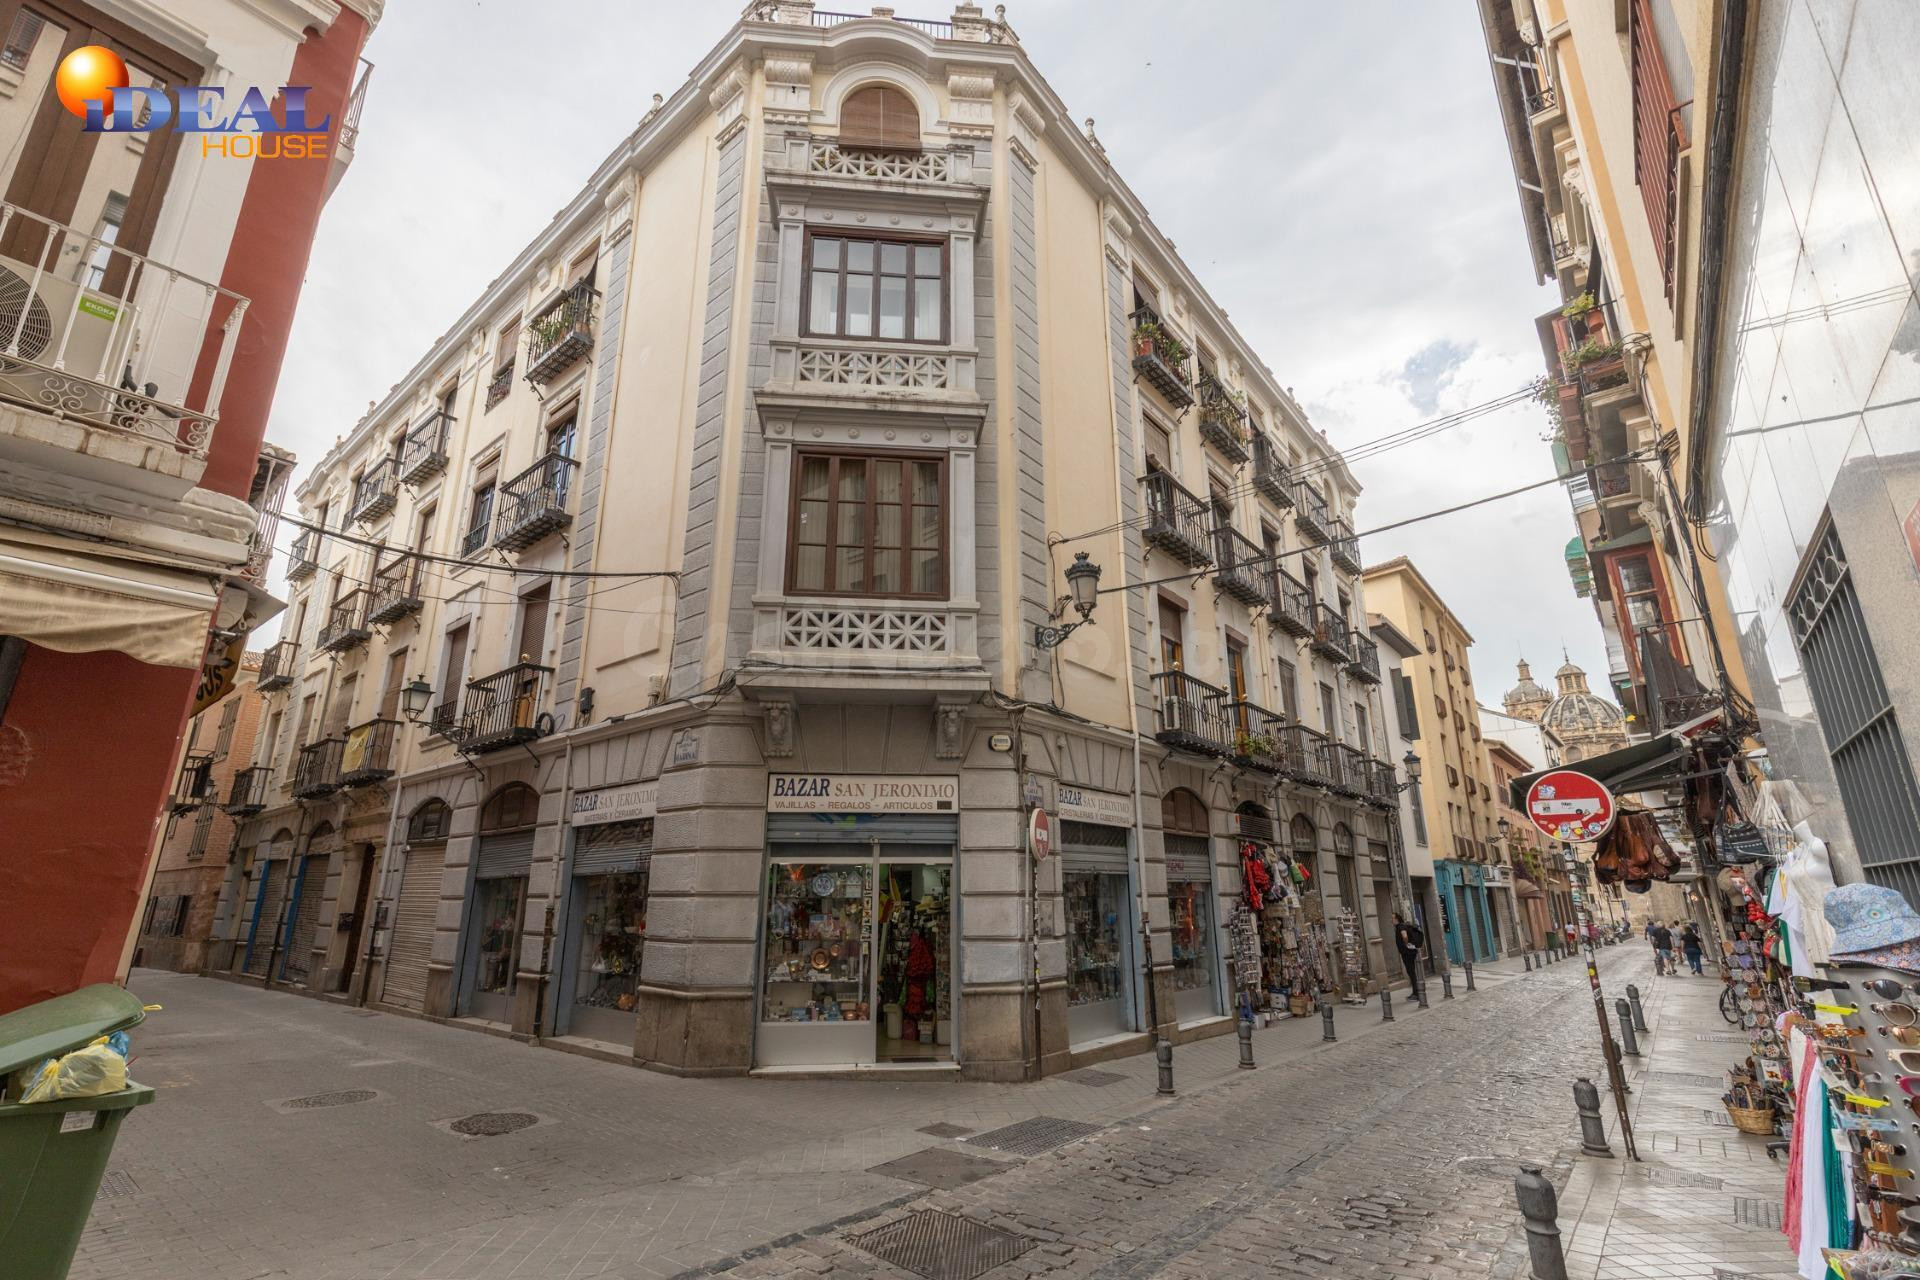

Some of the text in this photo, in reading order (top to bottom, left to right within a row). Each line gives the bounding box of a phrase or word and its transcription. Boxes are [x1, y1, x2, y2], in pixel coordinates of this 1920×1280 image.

[773, 778, 955, 801] BAZAR SAN JERONIMO
[572, 794, 599, 813] BAZAR
[599, 796, 614, 809] SAN
[775, 801, 933, 810] VAJILLAS REGALOS ARTICULOS
[1059, 788, 1082, 806] BAZAR
[1083, 797, 1096, 808] SAN
[1098, 799, 1130, 814] JERONIMO
